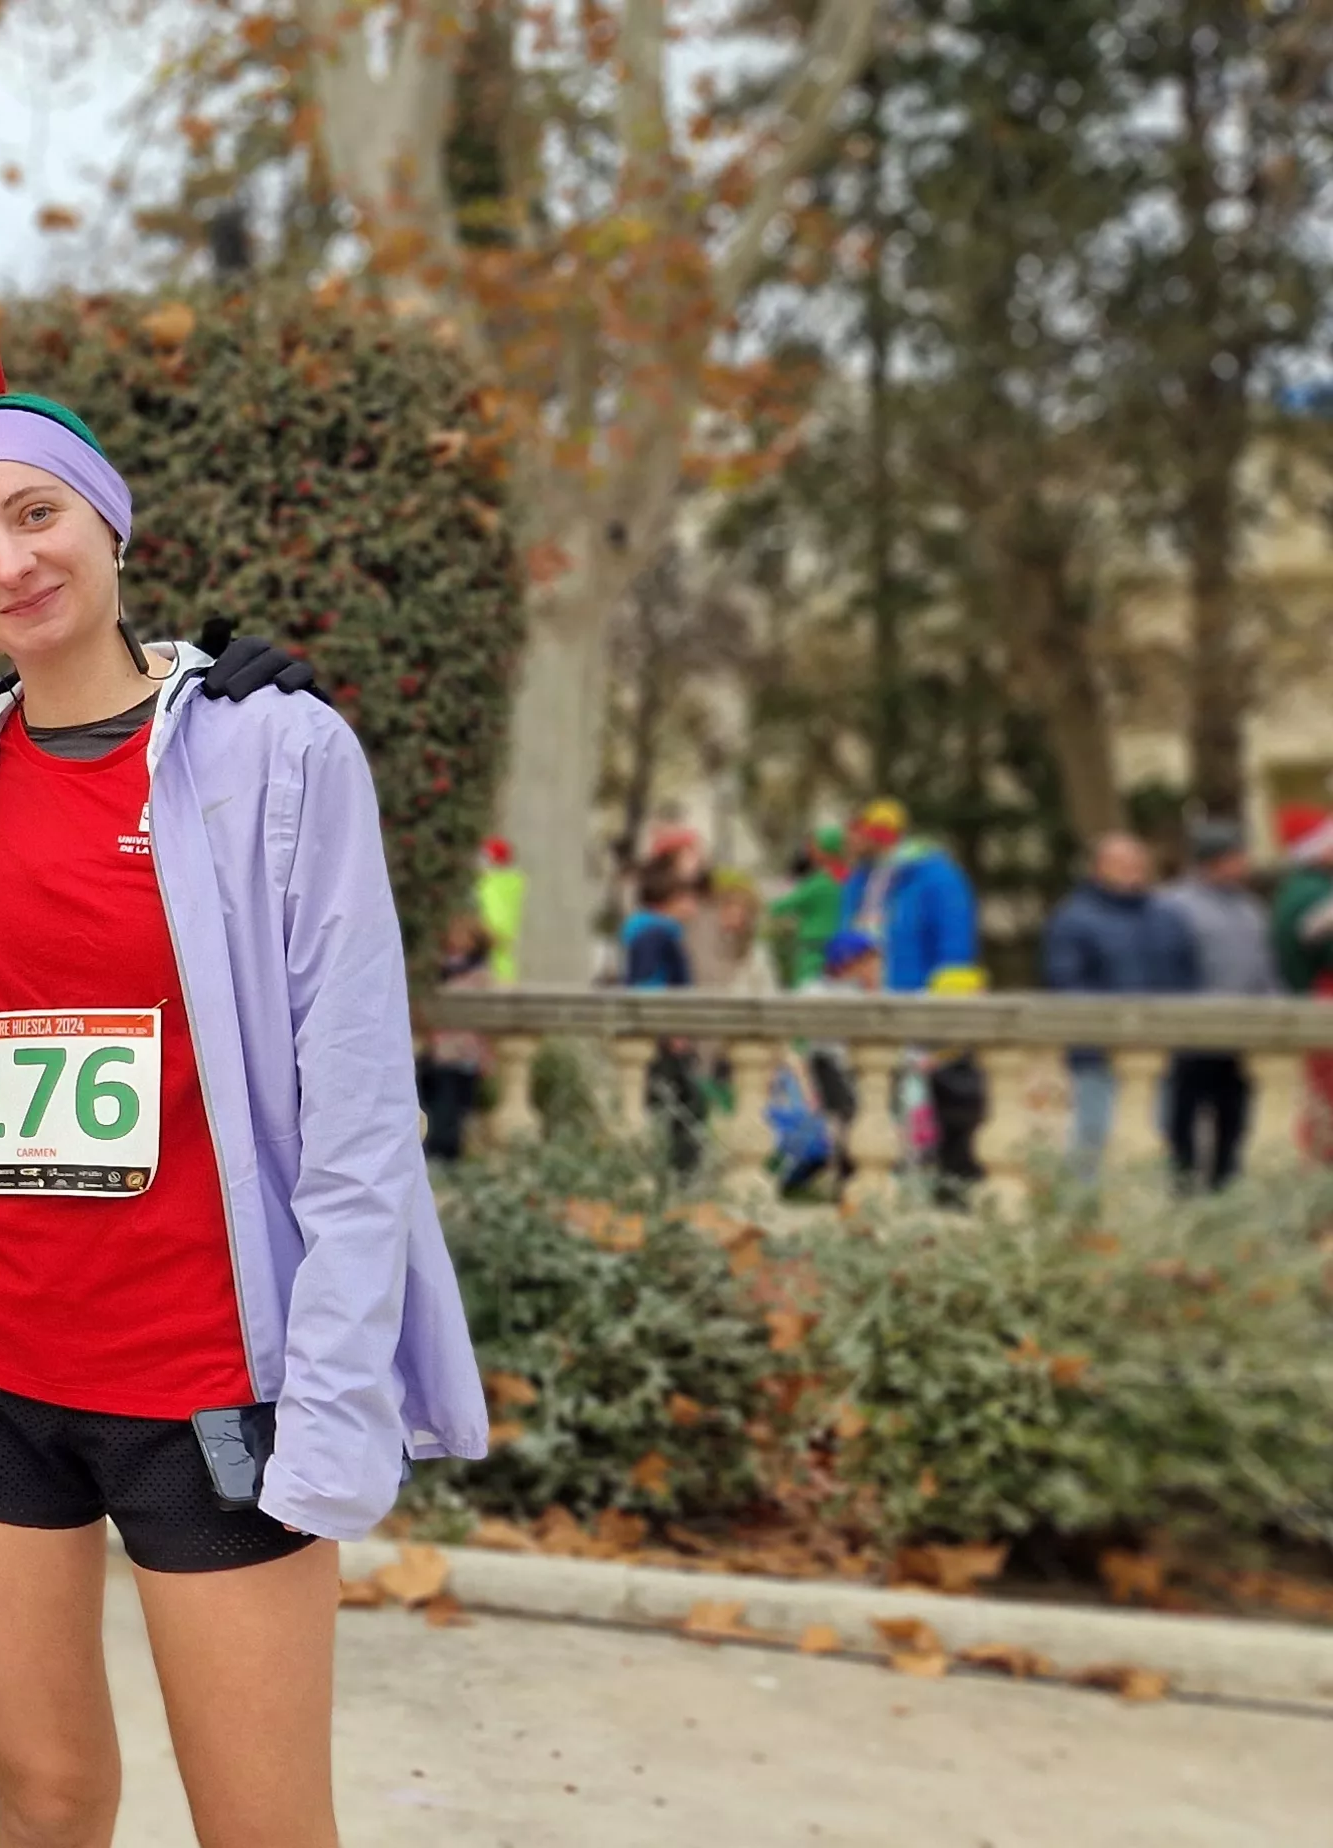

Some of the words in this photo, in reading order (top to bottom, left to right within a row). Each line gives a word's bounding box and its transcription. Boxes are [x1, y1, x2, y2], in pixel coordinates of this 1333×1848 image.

[117, 835, 151, 845] UNIVE
[119, 845, 134, 854] DE
[135, 845, 150, 855] LA
[12, 1019, 52, 1035] HUESCA
[55, 1017, 85, 1034] 2024
[16, 1148, 57, 1158] CARMEN
